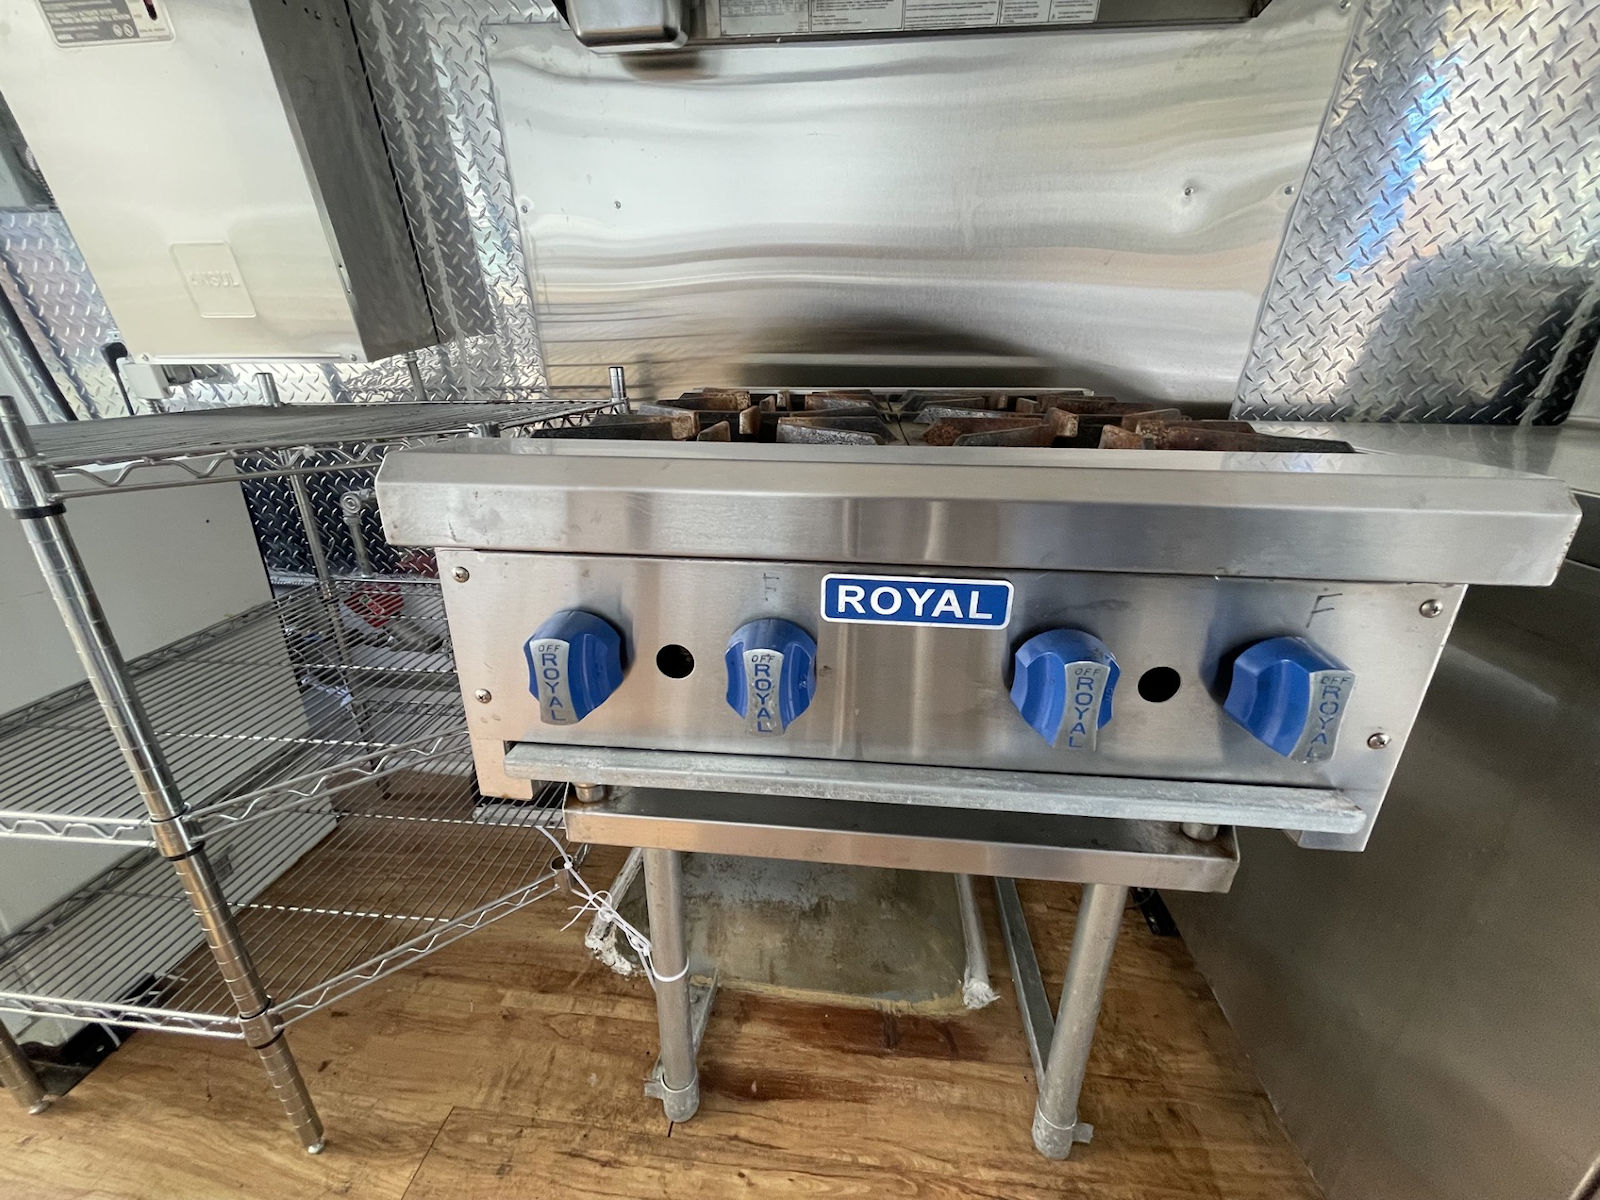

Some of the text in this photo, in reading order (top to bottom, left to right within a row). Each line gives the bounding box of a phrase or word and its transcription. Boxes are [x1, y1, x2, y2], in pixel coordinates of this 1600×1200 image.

[837, 584, 993, 620] ROYAL
[1306, 593, 1343, 628] F
[538, 644, 561, 652] OFF
[751, 654, 776, 663] OFF
[541, 653, 567, 721] ROYAL
[1074, 667, 1101, 676] OFF
[1320, 675, 1351, 685] OFF
[754, 663, 773, 733] ROYAL
[1068, 676, 1095, 748] ROYAL
[1306, 685, 1342, 759] ROYAL
